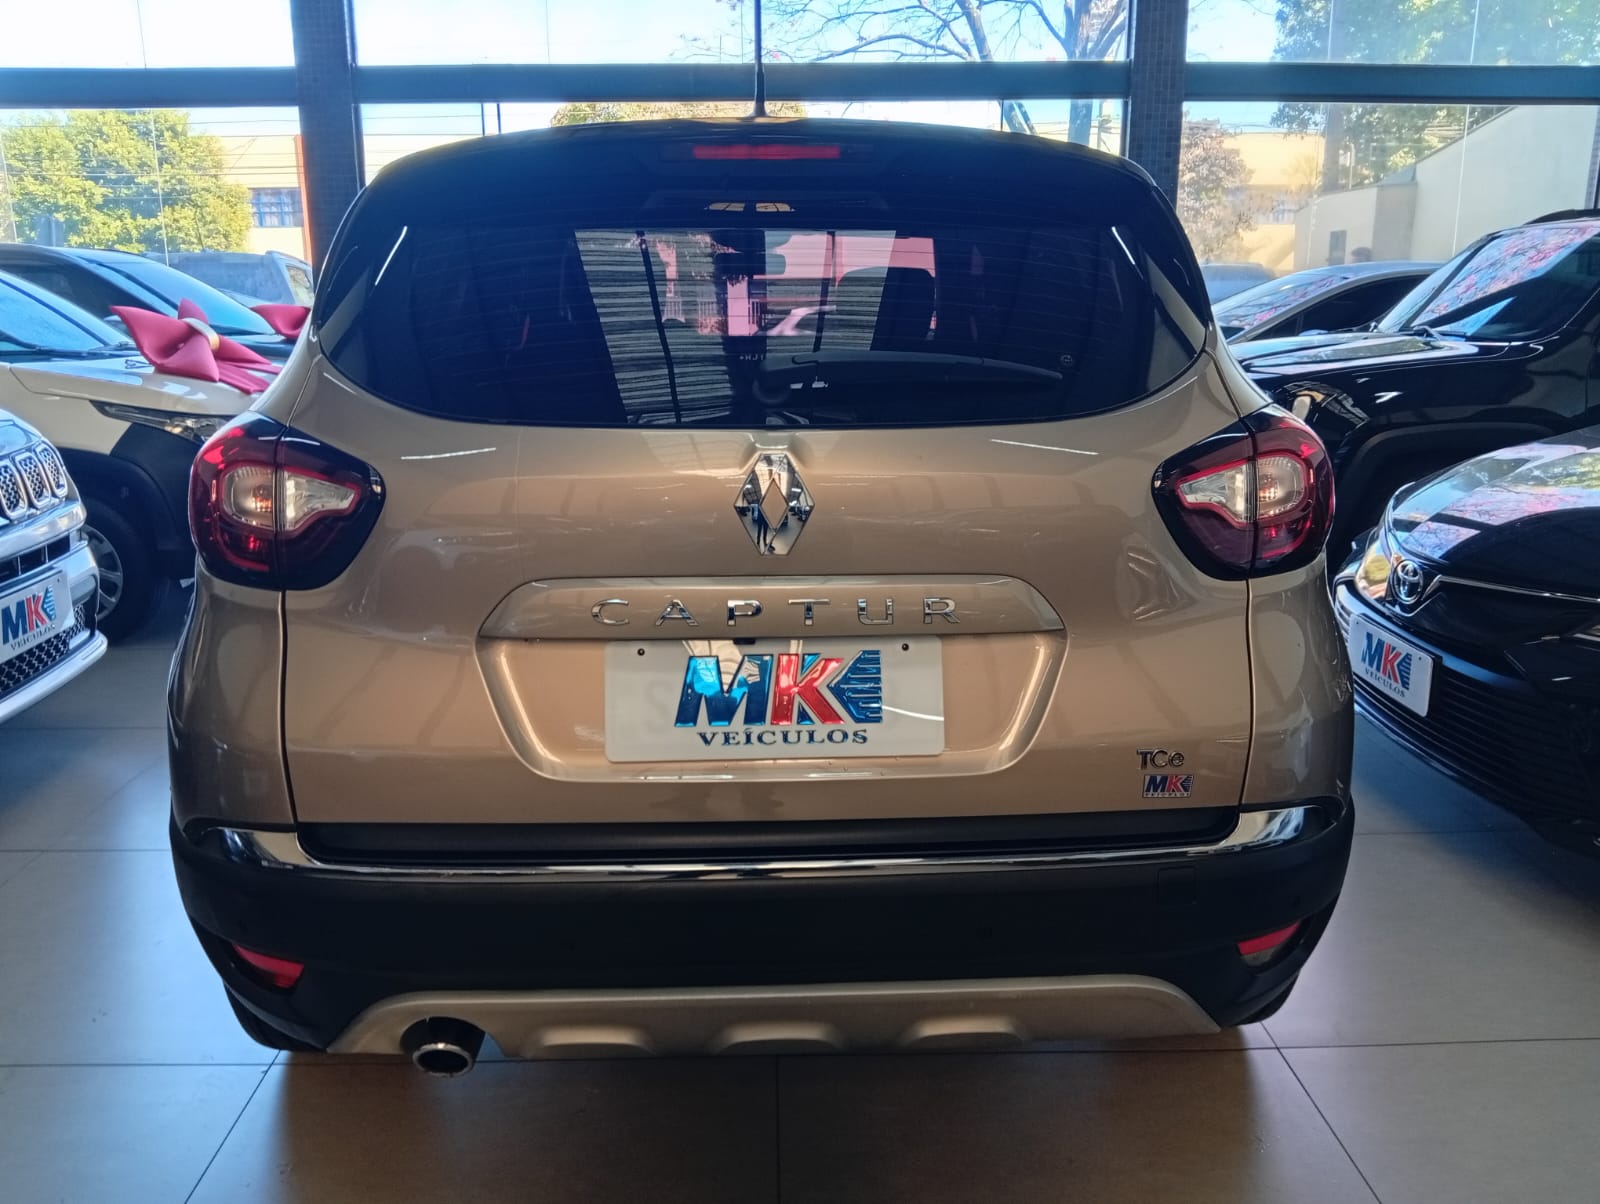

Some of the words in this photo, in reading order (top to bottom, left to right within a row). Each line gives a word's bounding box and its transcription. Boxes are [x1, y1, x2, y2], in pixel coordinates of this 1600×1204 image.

[1, 594, 48, 645] MK
[590, 597, 961, 627] CAPTUR
[1361, 631, 1403, 684] MK
[674, 653, 846, 728] MK
[697, 728, 869, 747] VEÍCULOS
[1136, 748, 1185, 770] TCe
[1144, 775, 1183, 793] MK
